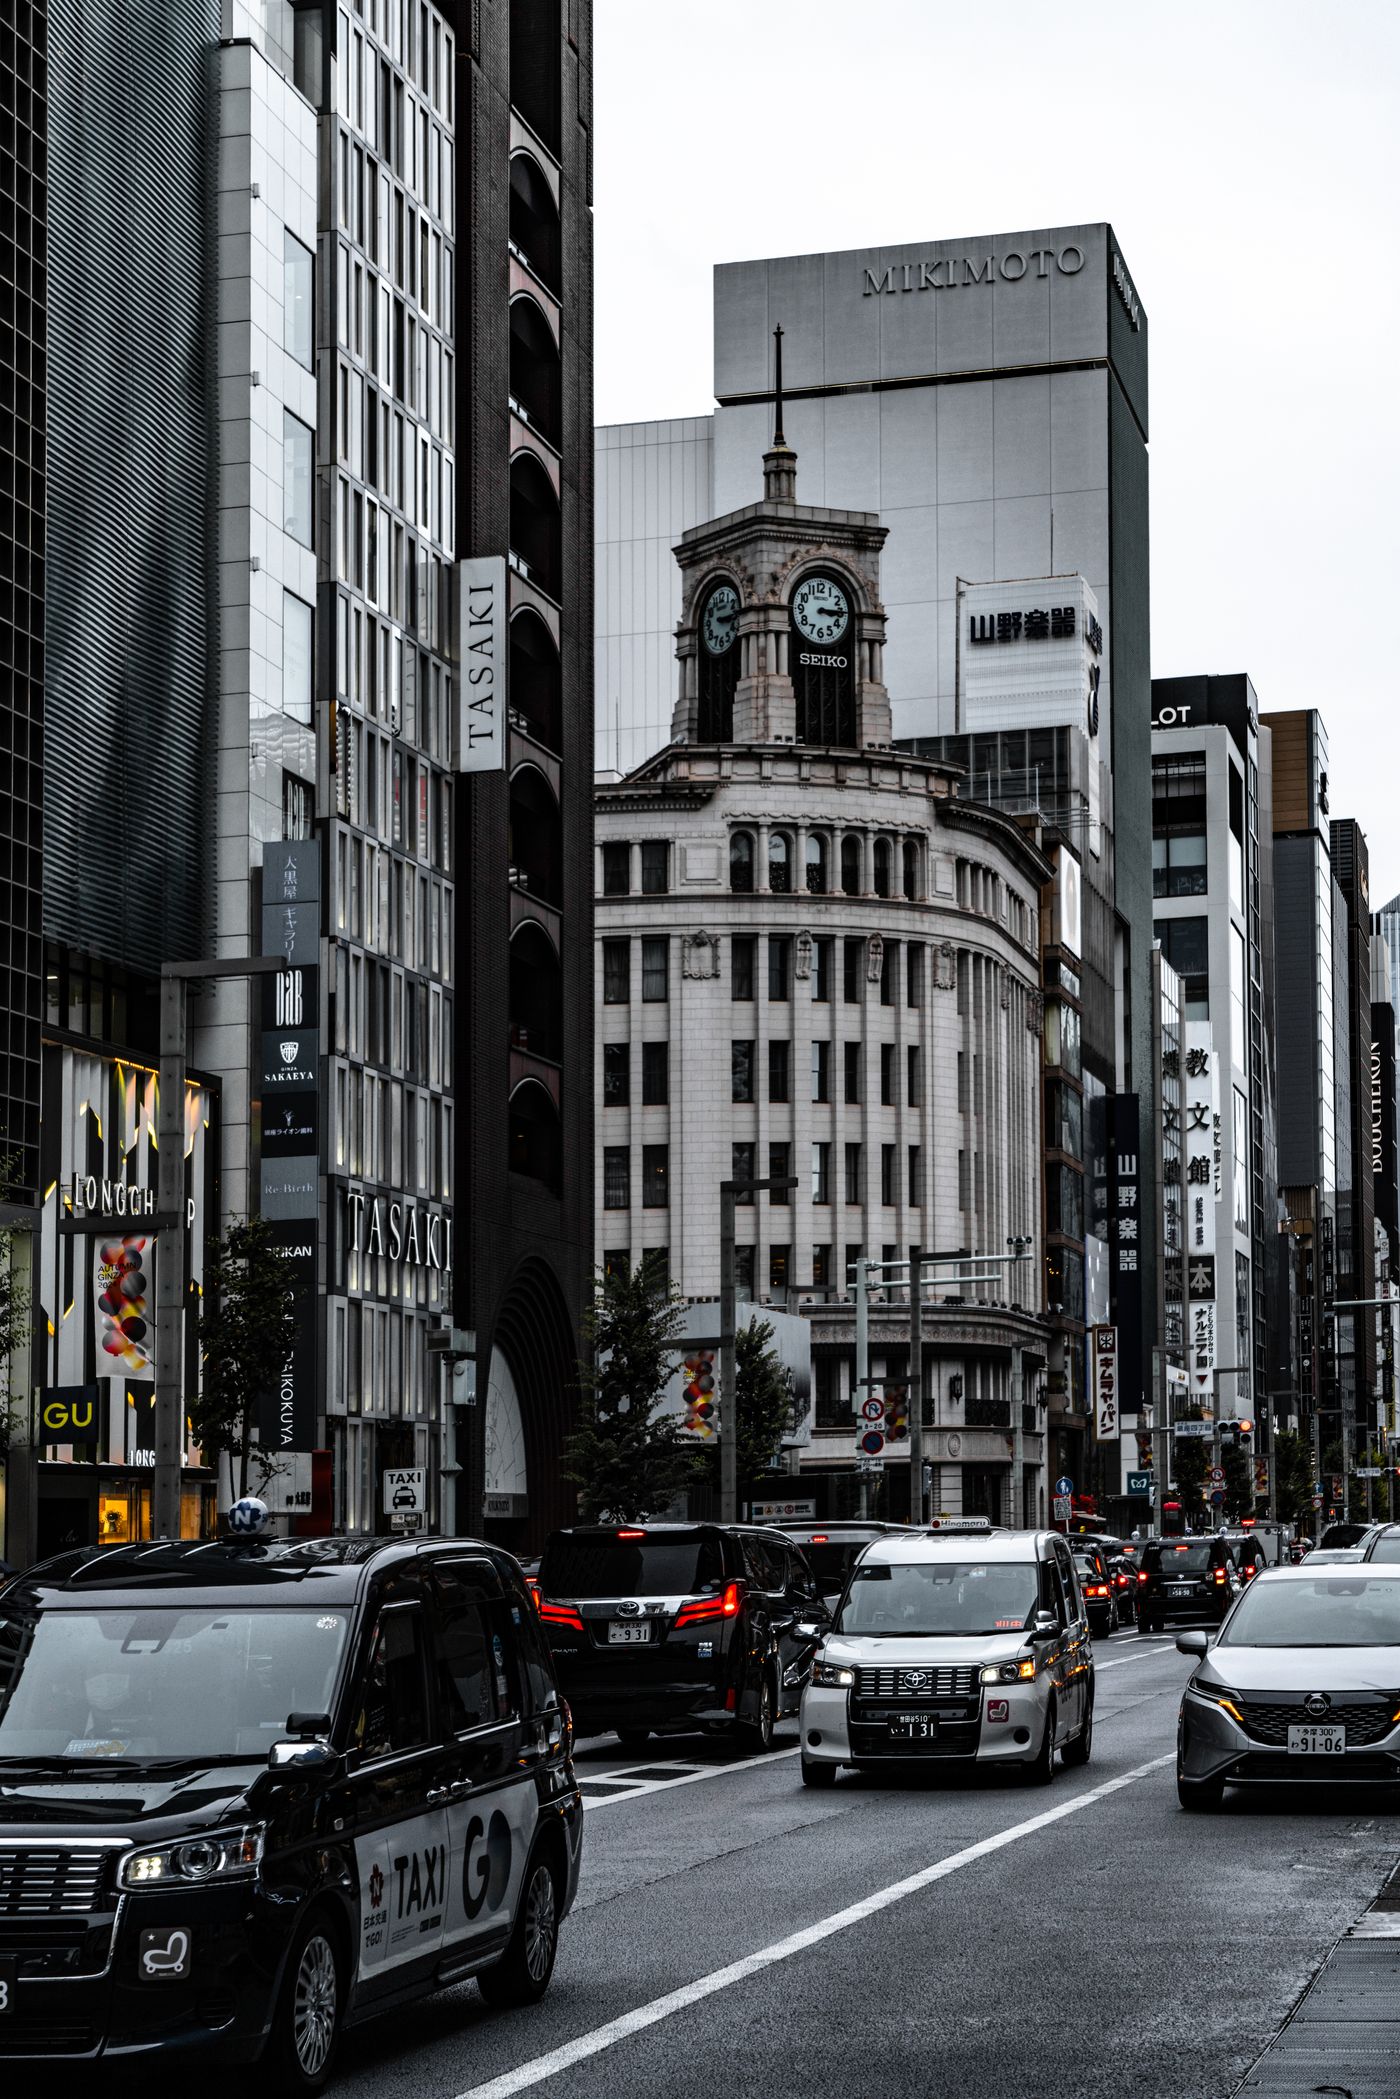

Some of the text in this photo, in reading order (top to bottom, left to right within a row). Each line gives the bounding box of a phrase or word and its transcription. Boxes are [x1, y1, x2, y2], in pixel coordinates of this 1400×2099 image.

[862, 245, 1086, 296] MIKIMOTO
[970, 606, 1076, 643] 山野楽器
[468, 583, 494, 749] TASAKI
[799, 653, 848, 668] SEIKO
[282, 906, 298, 963] ギャラリー
[264, 1072, 314, 1082] SAKAEYA
[1186, 1048, 1210, 1186] 教文館
[72, 1172, 196, 1230] LONGCHP
[1117, 1154, 1138, 1272] 山野楽器
[347, 1193, 453, 1272] TASAKI
[98, 1272, 125, 1281] GINZA
[1189, 1263, 1212, 1294] 本
[1100, 1356, 1116, 1435] キムラヤのパン
[42, 1402, 94, 1429] GU
[388, 1472, 421, 1484] TAXI
[234, 1510, 252, 1526] N
[940, 1520, 986, 1528] Hinomaru
[1300, 1738, 1342, 1752] 91-06
[1319, 1728, 1334, 1736] 300
[394, 1844, 444, 1920] TAXI
[462, 1810, 512, 1920] GO
[363, 1910, 388, 1931] 日本交通
